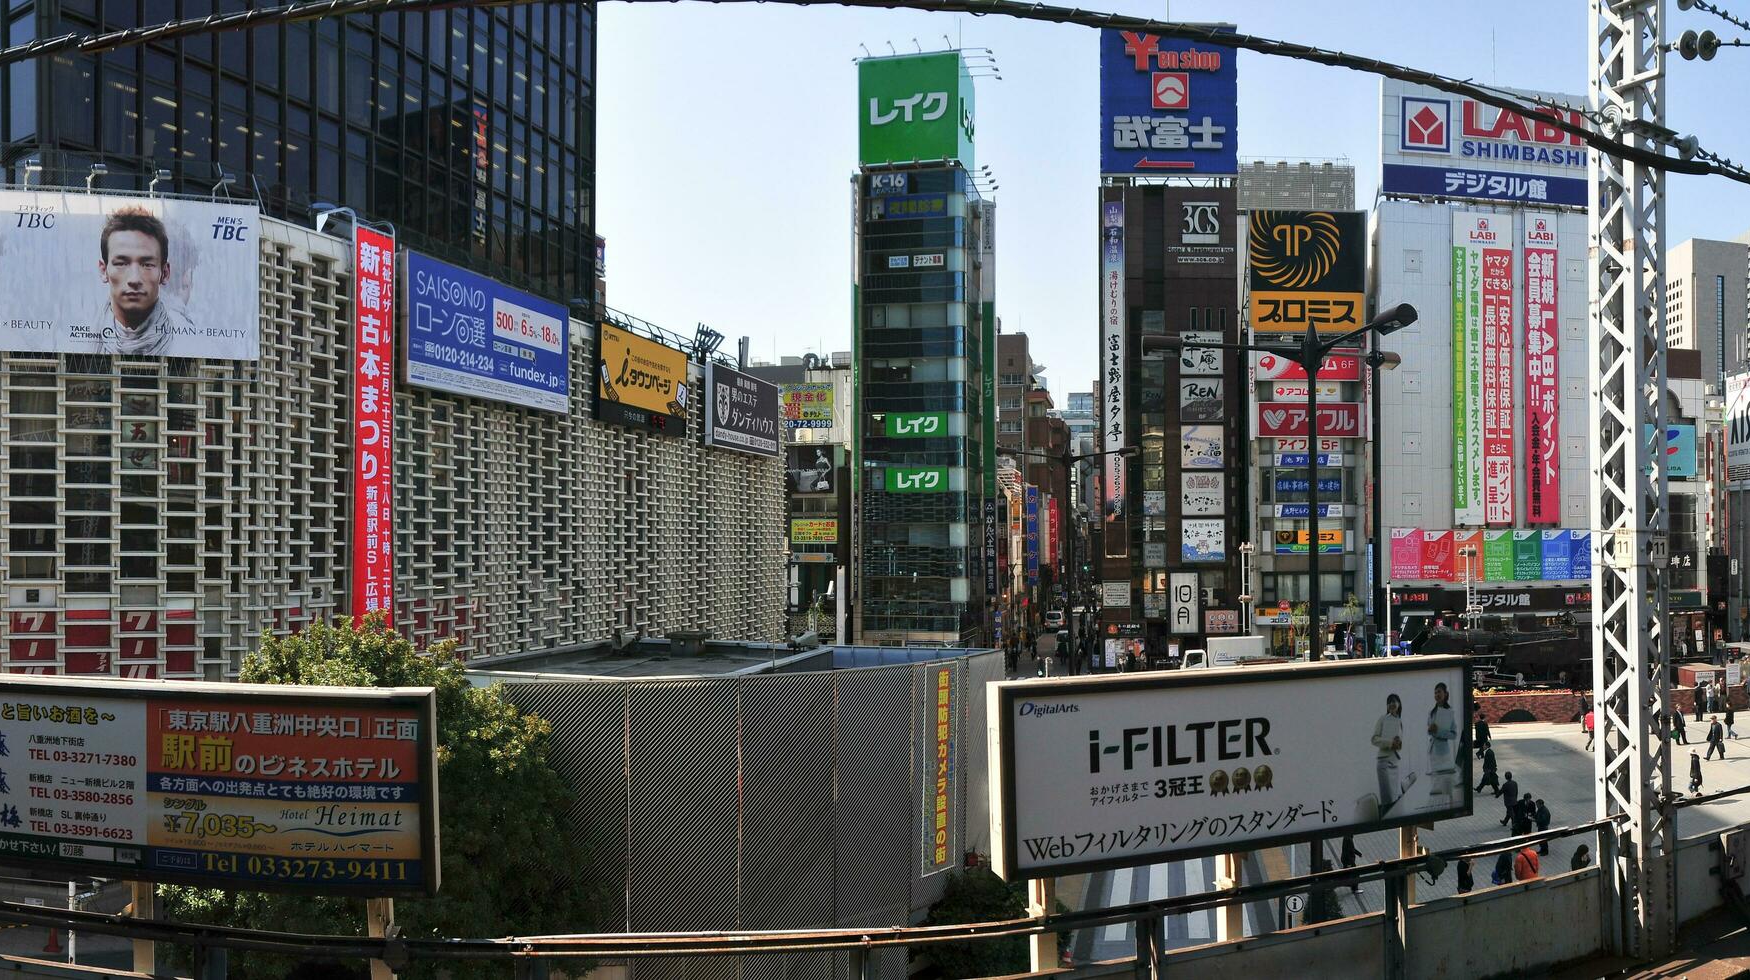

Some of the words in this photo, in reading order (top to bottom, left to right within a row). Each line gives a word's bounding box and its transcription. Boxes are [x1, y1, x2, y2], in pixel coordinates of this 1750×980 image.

[1180, 47, 1221, 71] shop
[869, 91, 948, 126] レイク
[1112, 115, 1227, 149] 武富士
[1461, 99, 1584, 147] LABI
[1461, 140, 1588, 168] SHIMBASHI
[872, 174, 905, 188] K-16
[1445, 171, 1548, 201] デジタル館
[14, 212, 55, 228] TBC
[217, 216, 243, 225] MEN'S
[212, 224, 248, 241] TBC
[1469, 230, 1497, 240] LABI
[1528, 231, 1555, 241] LABI
[1485, 255, 1510, 267] ヤマダ
[1541, 252, 1555, 305] 新規
[381, 249, 392, 344] 福祉バザール
[1257, 299, 1356, 325] プロミス
[10, 319, 54, 329] BEAUTY
[155, 325, 197, 335] HUMAN
[206, 328, 246, 338] BEAUTY
[1527, 251, 1542, 407] 会員募集中!!
[360, 240, 381, 480] 新橋古本まつり
[1341, 360, 1355, 369] 6F
[509, 361, 559, 389] fundex.jp
[1182, 380, 1220, 399] REN
[1541, 310, 1556, 485] LABIポイント
[731, 407, 775, 435] ダンディハウス
[896, 415, 939, 434] レイク
[1321, 440, 1339, 450] 5F
[1489, 443, 1507, 454] さらに
[896, 471, 940, 489] レイク
[1499, 461, 1510, 520] ポイント
[1616, 540, 1629, 554] 11
[1653, 541, 1666, 555] 11
[157, 708, 419, 741] 「東京駅八重洲中央口」正面
[28, 734, 85, 748] 八重洲地下街店
[1088, 716, 1274, 774] i-FILTER
[28, 748, 51, 761] TEL
[52, 750, 137, 767] 03-3271-7380
[28, 773, 52, 784] 新橋店
[1154, 774, 1204, 799] 3冠王
[29, 786, 51, 798] TEL
[53, 788, 134, 806] 03-3580-2856
[159, 776, 404, 801] 各方面への出発点とても絶好の環境です
[1089, 781, 1149, 796] おかげさまで
[163, 796, 207, 811] シングル
[1090, 792, 1149, 806] アイフィルター
[29, 807, 53, 818] 新橋店
[60, 809, 73, 819] SL
[280, 808, 310, 820] Hotel
[315, 804, 403, 826] Heimat
[29, 820, 51, 833] TEL
[54, 823, 133, 841] 03-3591-6623
[61, 842, 85, 857] 初藤
[290, 842, 329, 853] ホテル
[333, 842, 395, 853] ハイマート
[201, 852, 237, 873] Tel
